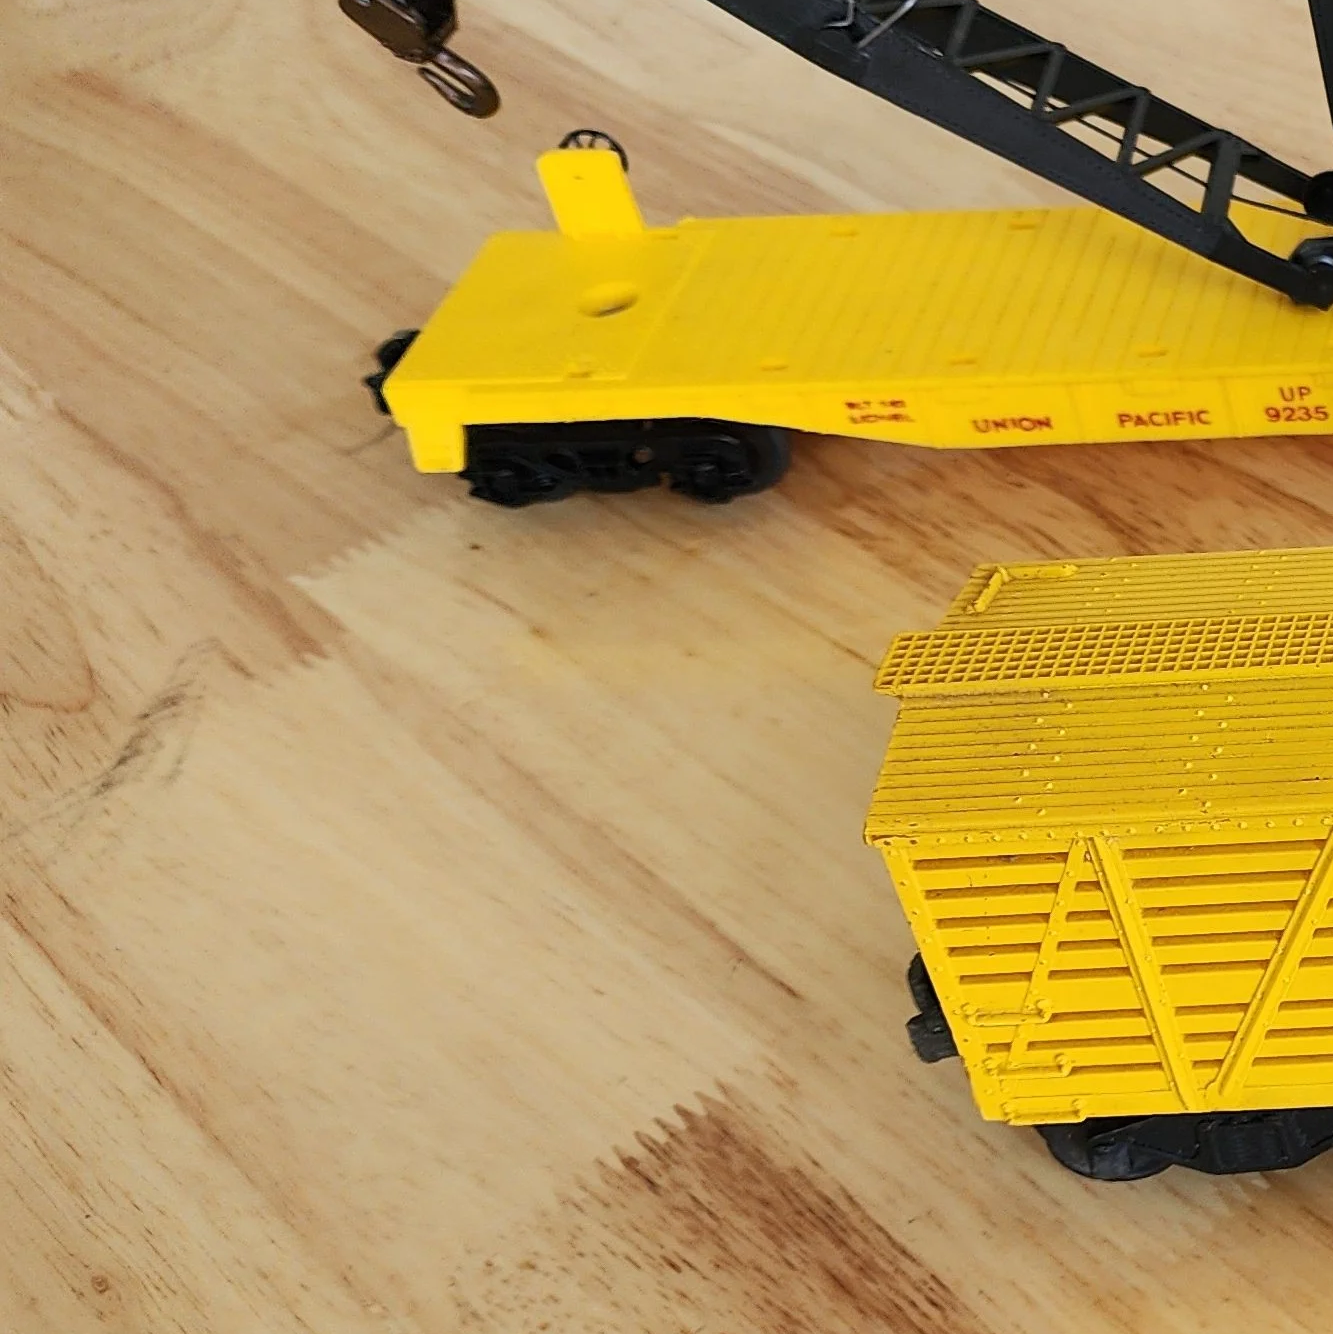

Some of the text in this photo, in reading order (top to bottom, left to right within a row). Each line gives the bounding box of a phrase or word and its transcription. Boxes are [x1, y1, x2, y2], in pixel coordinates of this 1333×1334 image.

[1279, 385, 1312, 403] UP
[971, 409, 1212, 434] UNION PACIFIC
[1263, 405, 1331, 424] 9235
